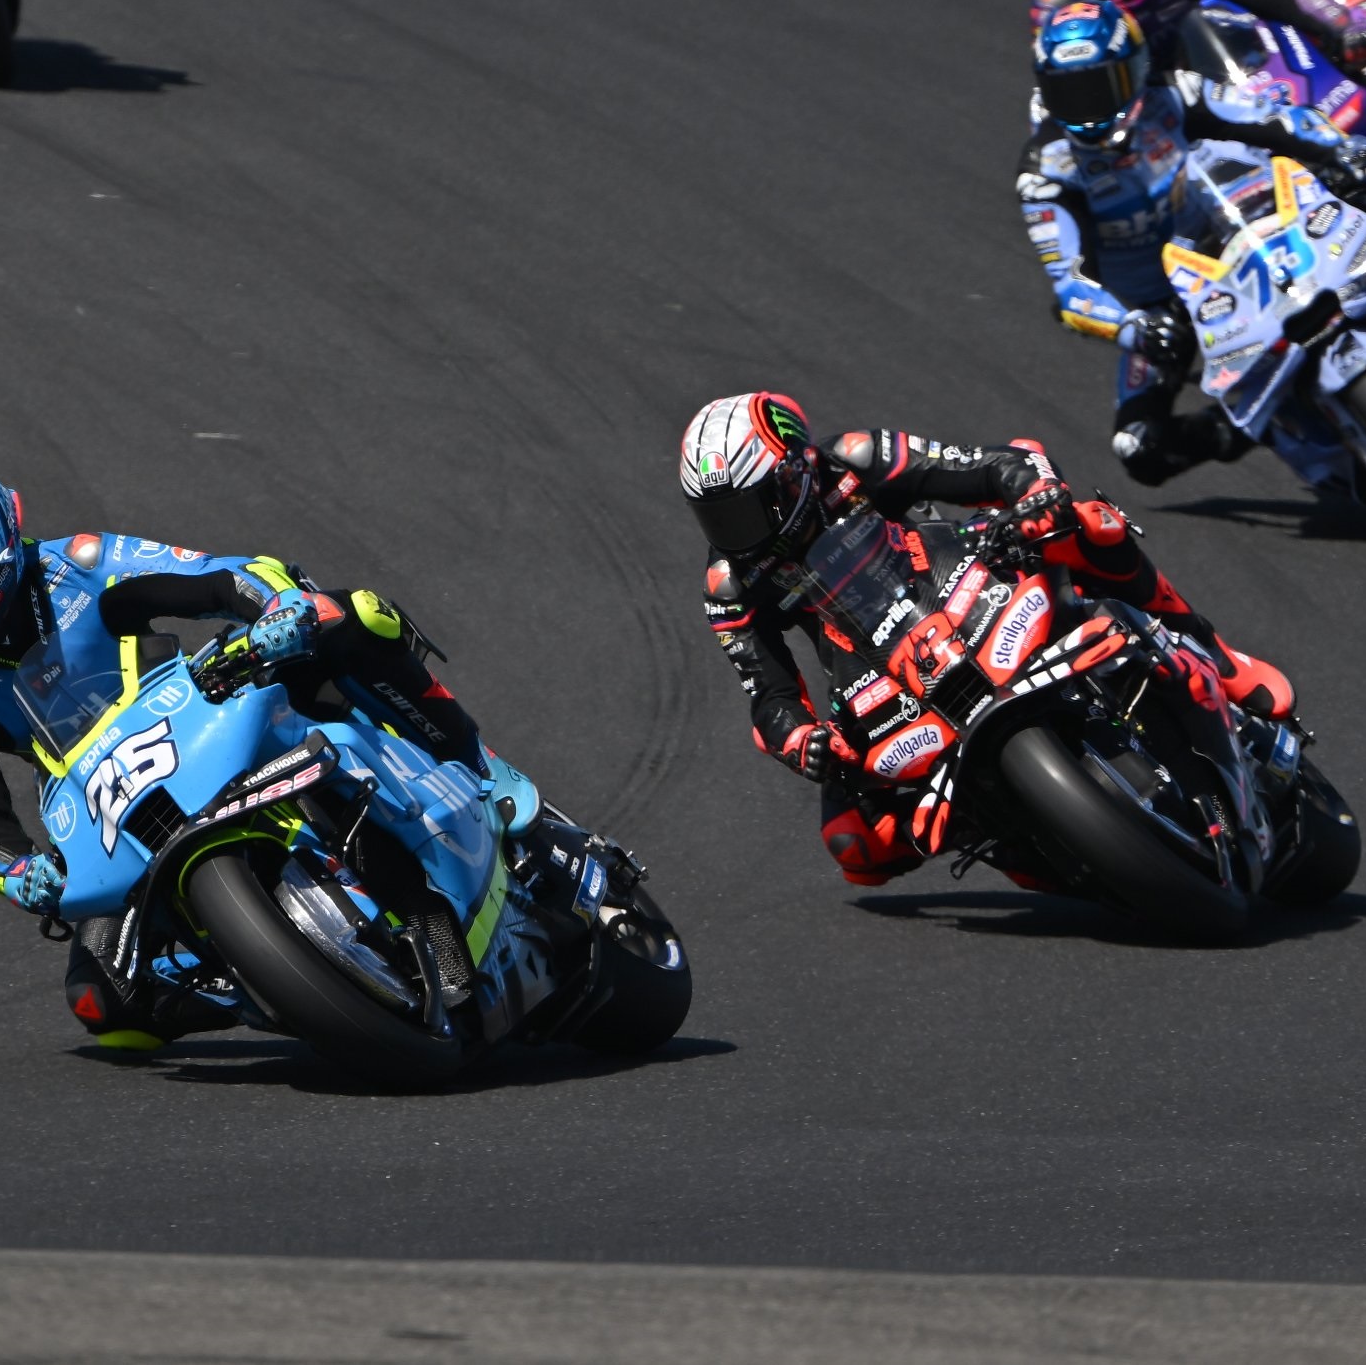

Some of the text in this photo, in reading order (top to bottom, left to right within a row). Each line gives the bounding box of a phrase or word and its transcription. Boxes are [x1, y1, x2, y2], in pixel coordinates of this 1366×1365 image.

[1233, 223, 1318, 313] 73
[704, 470, 726, 484] agv
[938, 554, 977, 599] TARGA
[948, 568, 985, 615] BS
[56, 590, 88, 627] TRACKHOUSE
[871, 598, 916, 647] aprilia
[967, 605, 998, 647] PRAGMATIC
[994, 593, 1045, 665] sterilgarda
[843, 669, 879, 701] TARGA
[854, 680, 892, 714] BS
[373, 682, 447, 743] DAINESE
[868, 712, 905, 740] PRAGMATIC
[78, 726, 122, 776] aprilia
[242, 749, 311, 787] TRACKHOUSE
[879, 727, 939, 775] sterilgarda
[85, 715, 181, 860] 25
